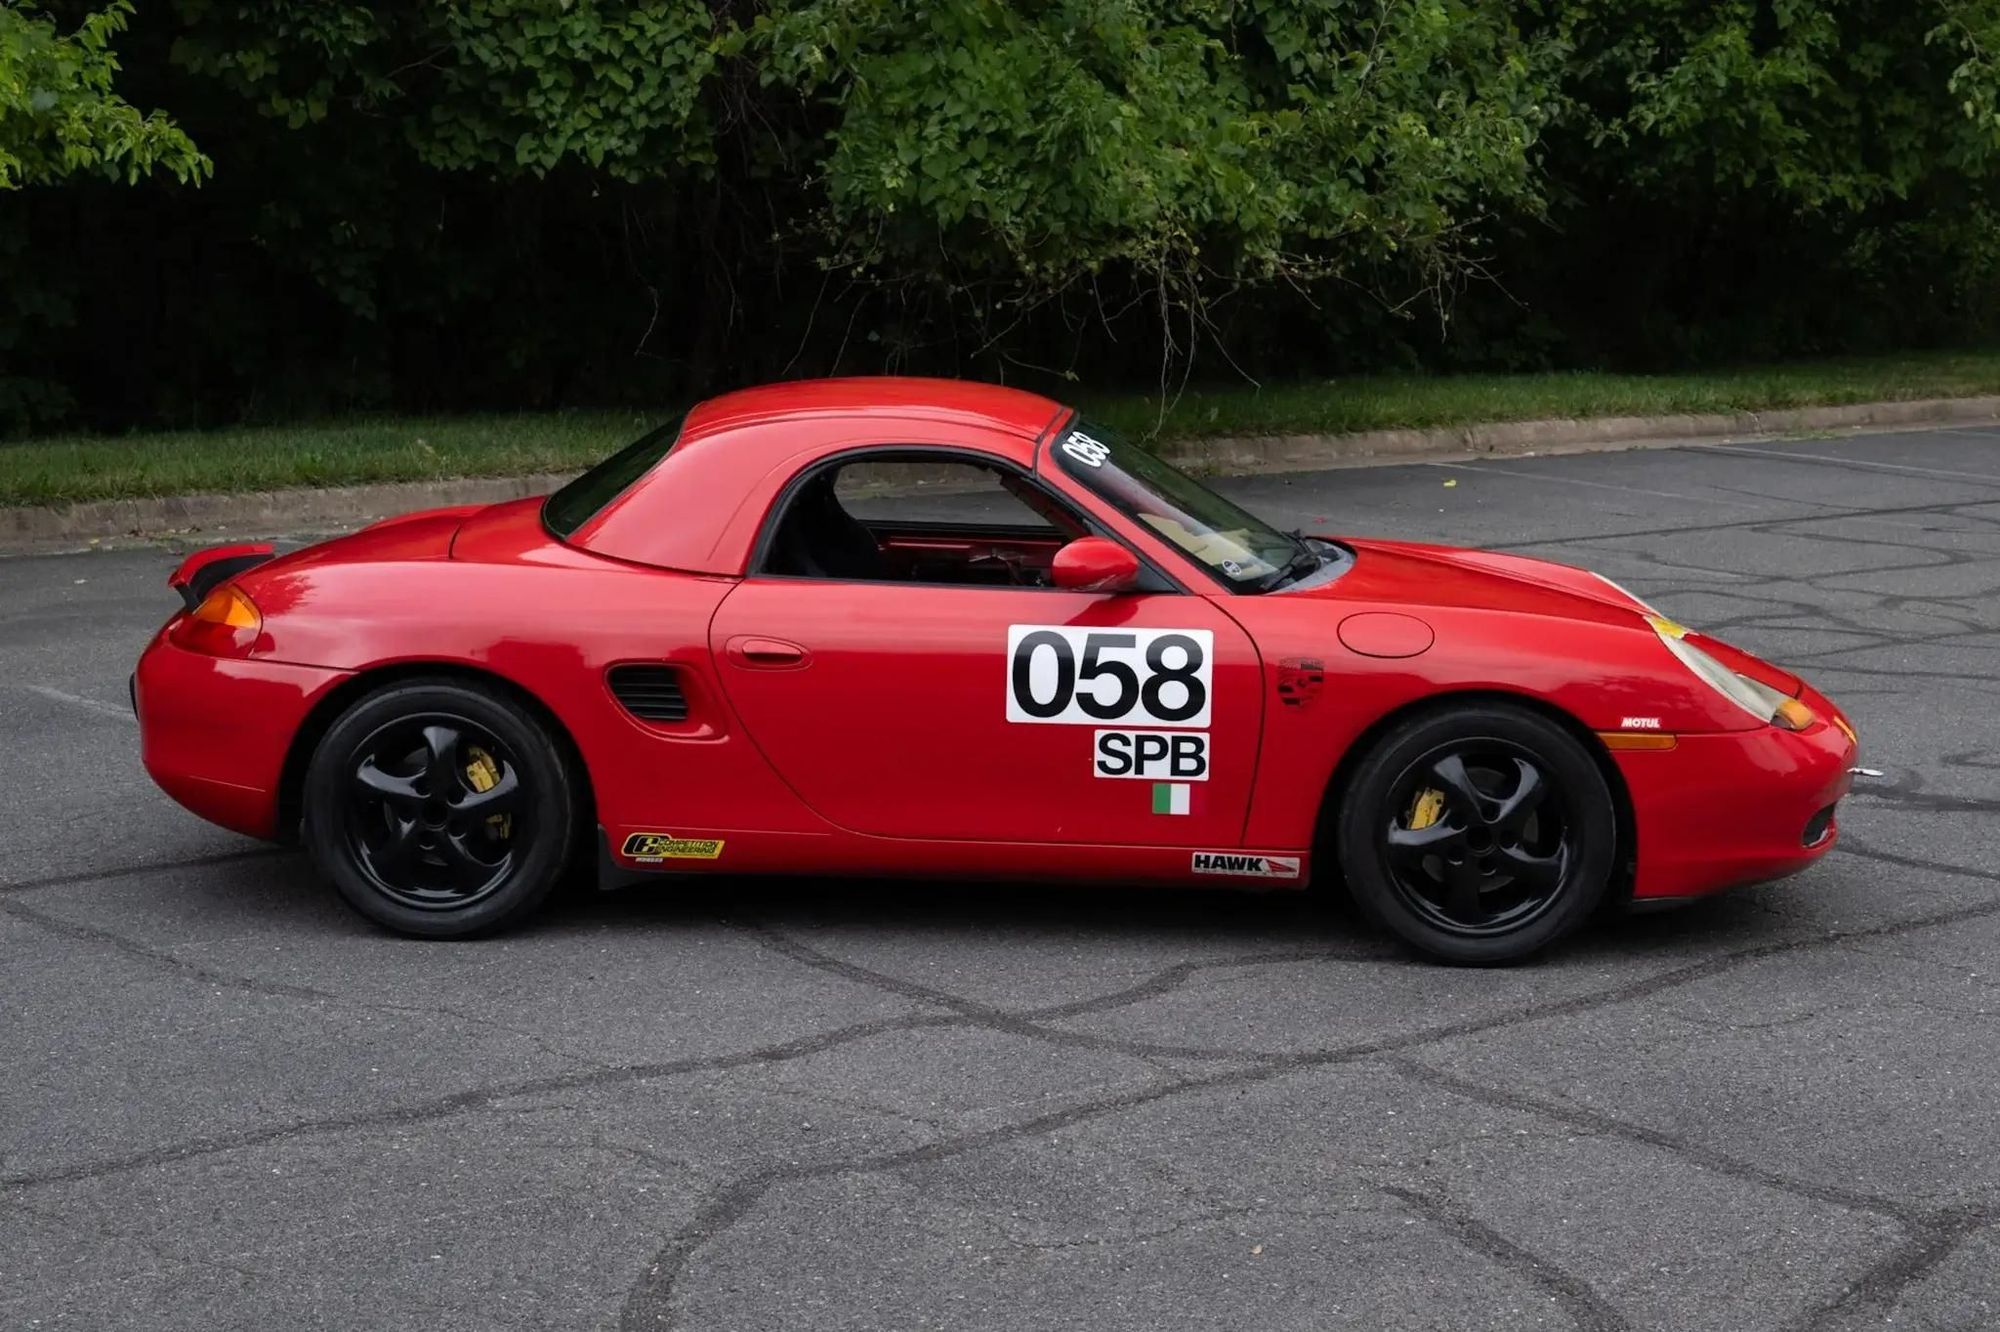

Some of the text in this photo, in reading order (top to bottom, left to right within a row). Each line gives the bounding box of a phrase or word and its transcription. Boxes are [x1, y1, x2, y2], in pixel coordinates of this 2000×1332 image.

[1062, 431, 1111, 468] 058
[1012, 630, 1206, 722] 058
[1621, 717, 1660, 729] MOTUL
[1097, 733, 1206, 777] SPB
[1194, 854, 1263, 872] HAWK
